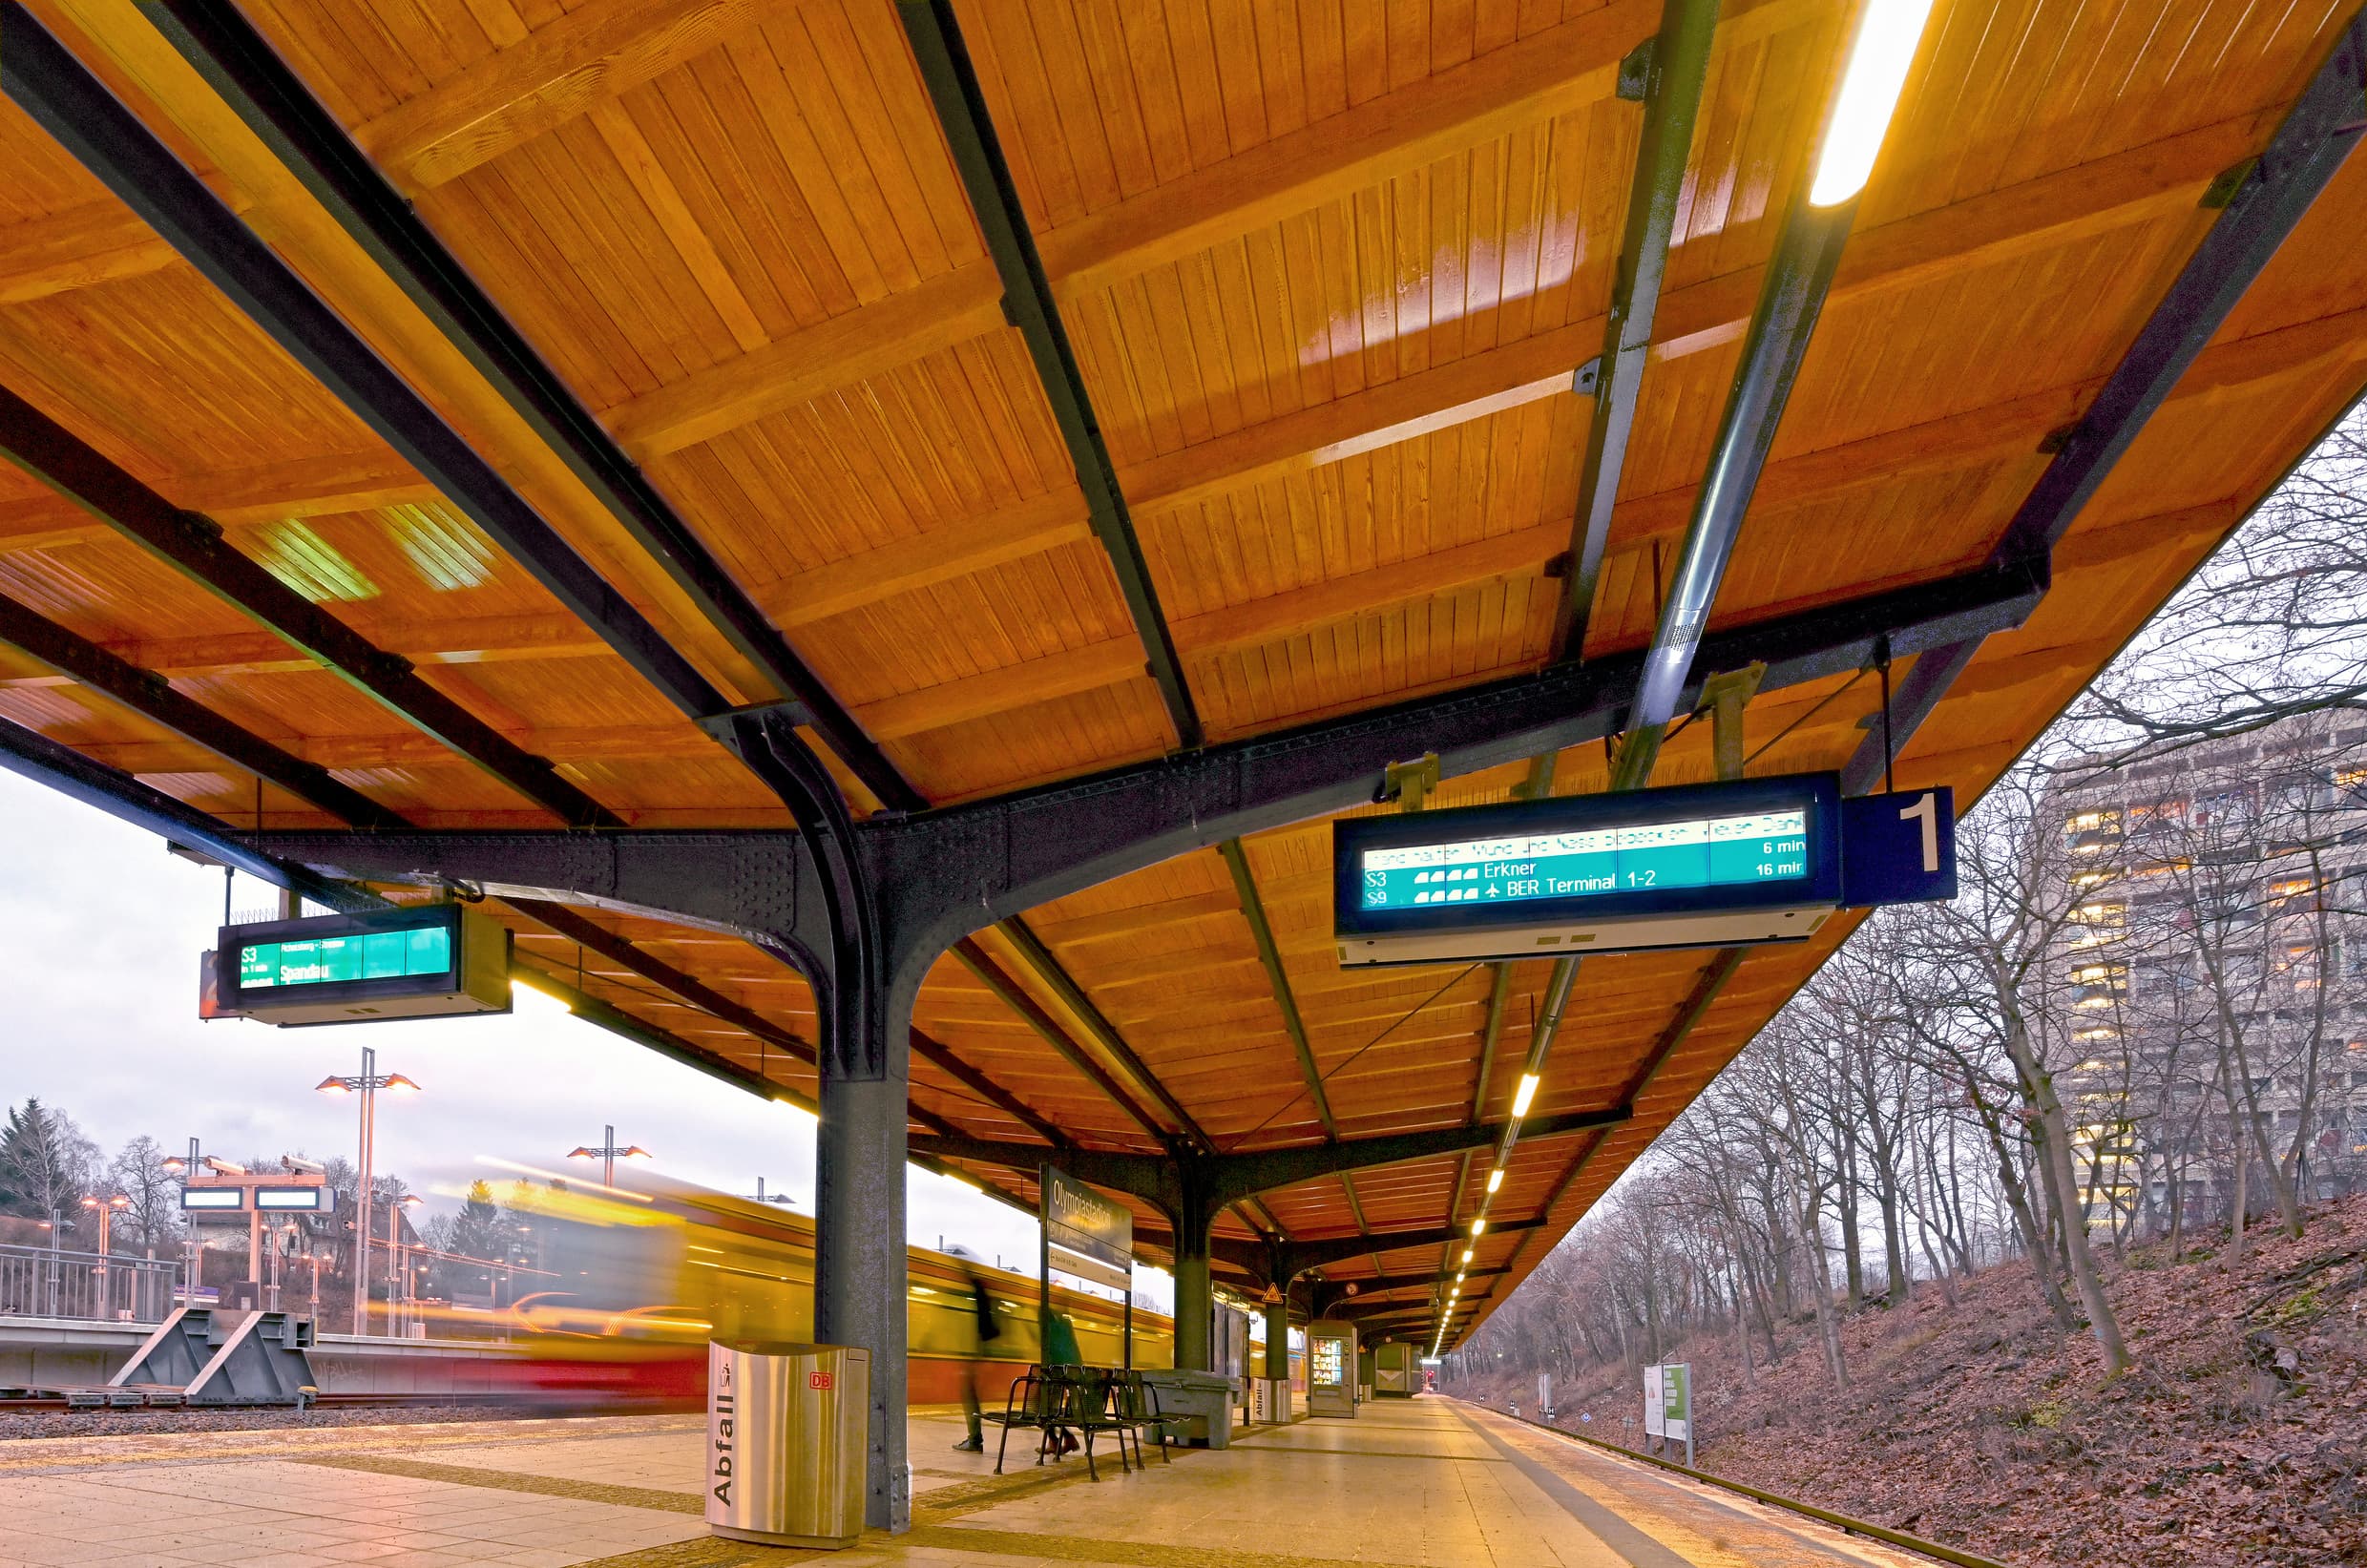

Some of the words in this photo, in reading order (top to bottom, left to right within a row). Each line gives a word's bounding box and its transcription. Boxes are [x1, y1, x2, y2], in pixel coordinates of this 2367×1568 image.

[1900, 793, 1938, 871] 1
[1366, 871, 1387, 888] S3
[1484, 862, 1538, 878] Erkner
[1763, 841, 1772, 854] 6
[1777, 839, 1805, 853] min
[1366, 891, 1387, 906] S9
[1507, 880, 1540, 896] BER
[1546, 873, 1617, 893] Terminal
[1628, 869, 1657, 888] 1-2
[1756, 863, 1773, 876] 16
[241, 947, 257, 963] S3
[281, 964, 328, 985] Spandau
[1053, 1180, 1111, 1230] Olympiastadion
[812, 1374, 830, 1388] DB
[714, 1395, 734, 1508] Abfall
